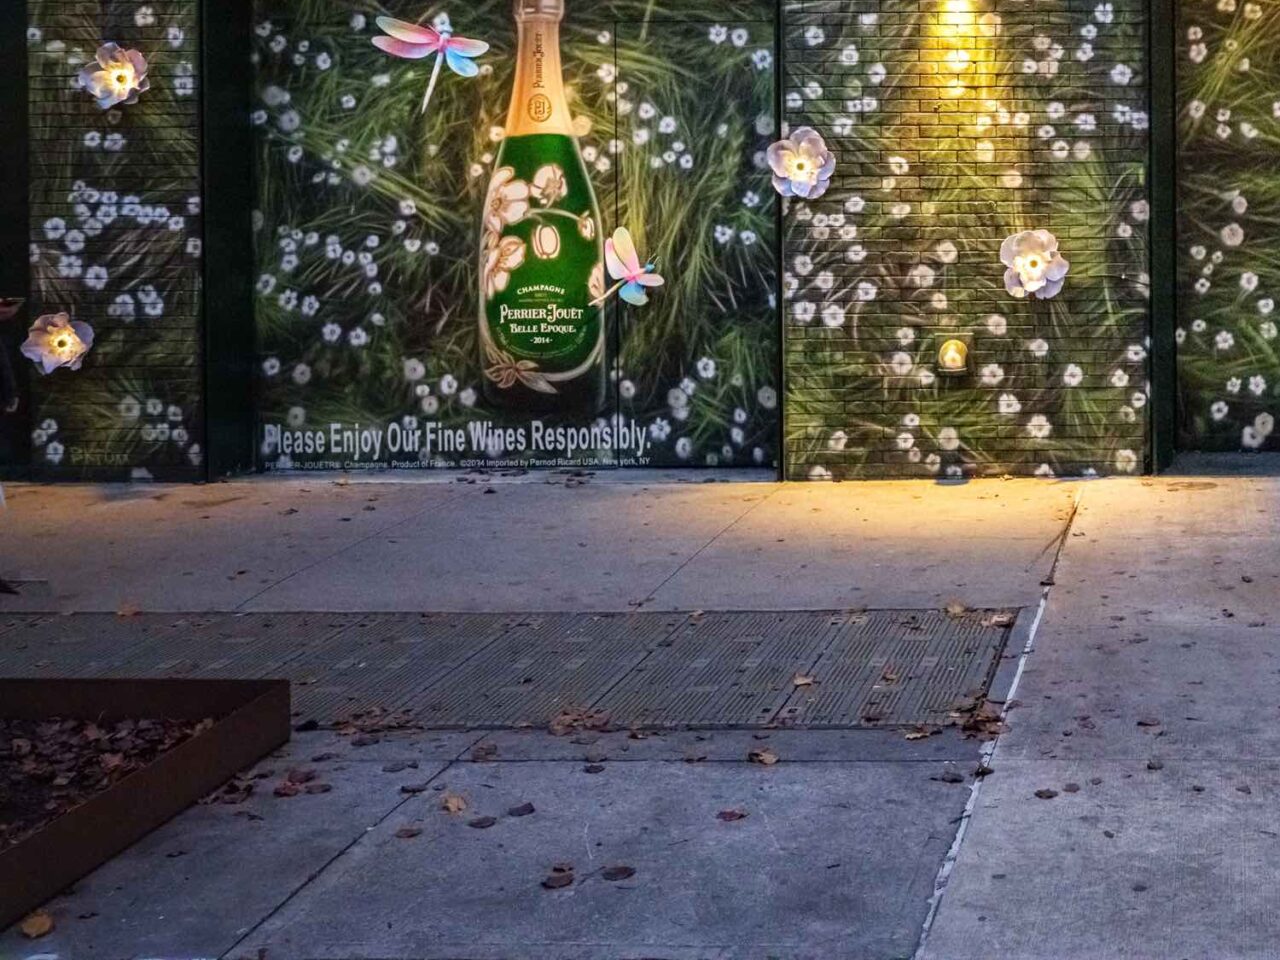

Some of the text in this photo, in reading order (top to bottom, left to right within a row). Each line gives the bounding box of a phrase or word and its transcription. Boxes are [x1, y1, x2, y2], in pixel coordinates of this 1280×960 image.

[517, 284, 566, 296] CHAMPAGNE
[510, 323, 538, 333] BELLE
[264, 419, 651, 460] Please Enjoy Our Fine Wines Responsibly.
[486, 459, 519, 469] Imported
[520, 459, 529, 469] by
